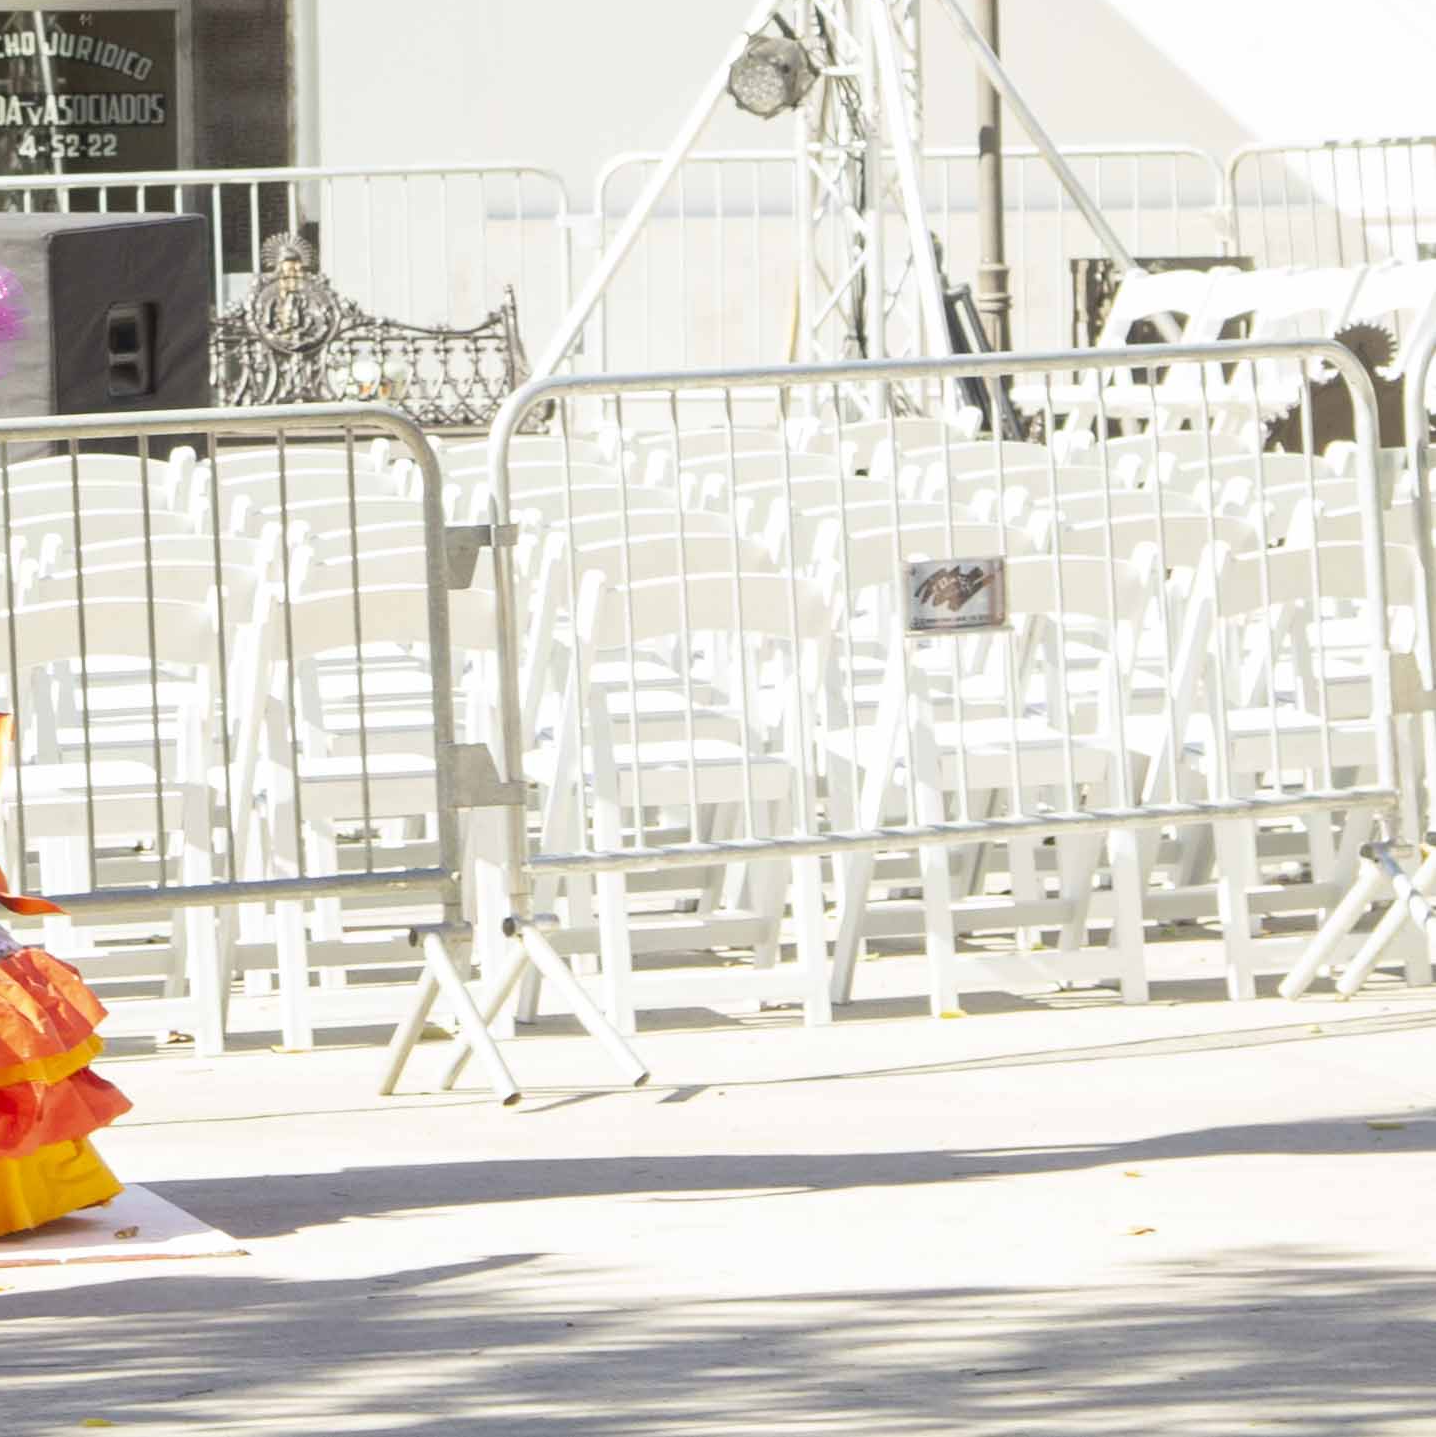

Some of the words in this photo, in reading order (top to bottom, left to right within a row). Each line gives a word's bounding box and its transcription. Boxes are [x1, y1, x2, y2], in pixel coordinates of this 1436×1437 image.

[44, 31, 153, 81] JURIDICO
[43, 94, 165, 127] ASOCIADOS
[18, 133, 117, 158] 4-52-22
